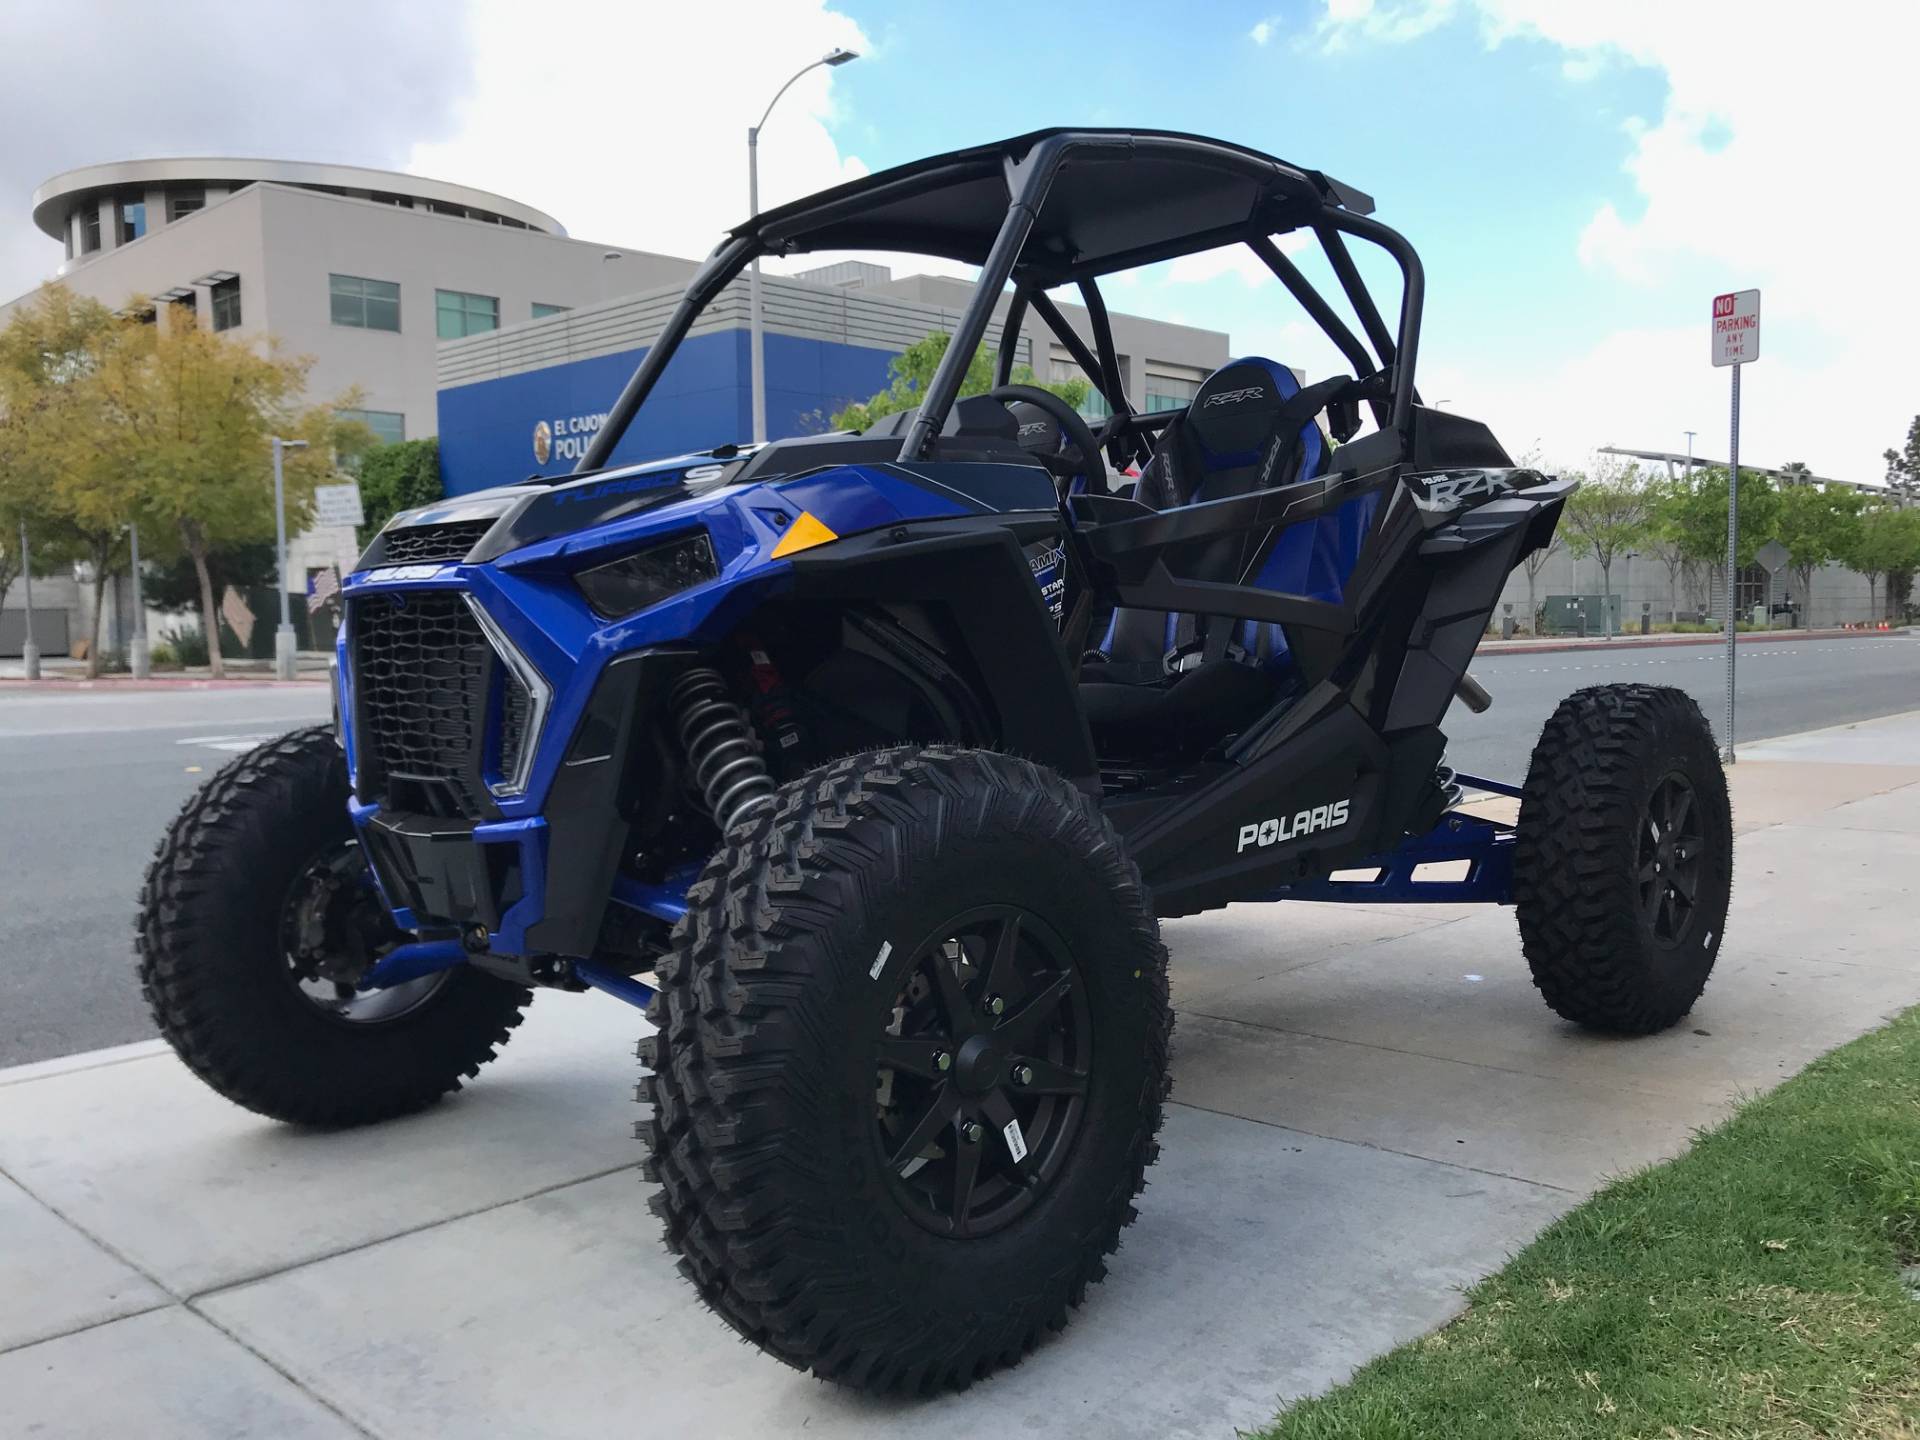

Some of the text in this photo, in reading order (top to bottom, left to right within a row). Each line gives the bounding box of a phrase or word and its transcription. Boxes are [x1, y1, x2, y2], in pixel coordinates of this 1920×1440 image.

[1714, 297, 1733, 316] NO
[1716, 314, 1756, 333] PARKING
[1726, 332, 1744, 345] ANY
[1725, 344, 1745, 357] TIME
[1203, 386, 1265, 409] RZR
[554, 413, 609, 436] EL CAJON
[555, 436, 594, 460] POLI
[1420, 474, 1449, 486] POLARIS
[1429, 468, 1515, 512] RZR
[1237, 799, 1350, 853] POLARIS
